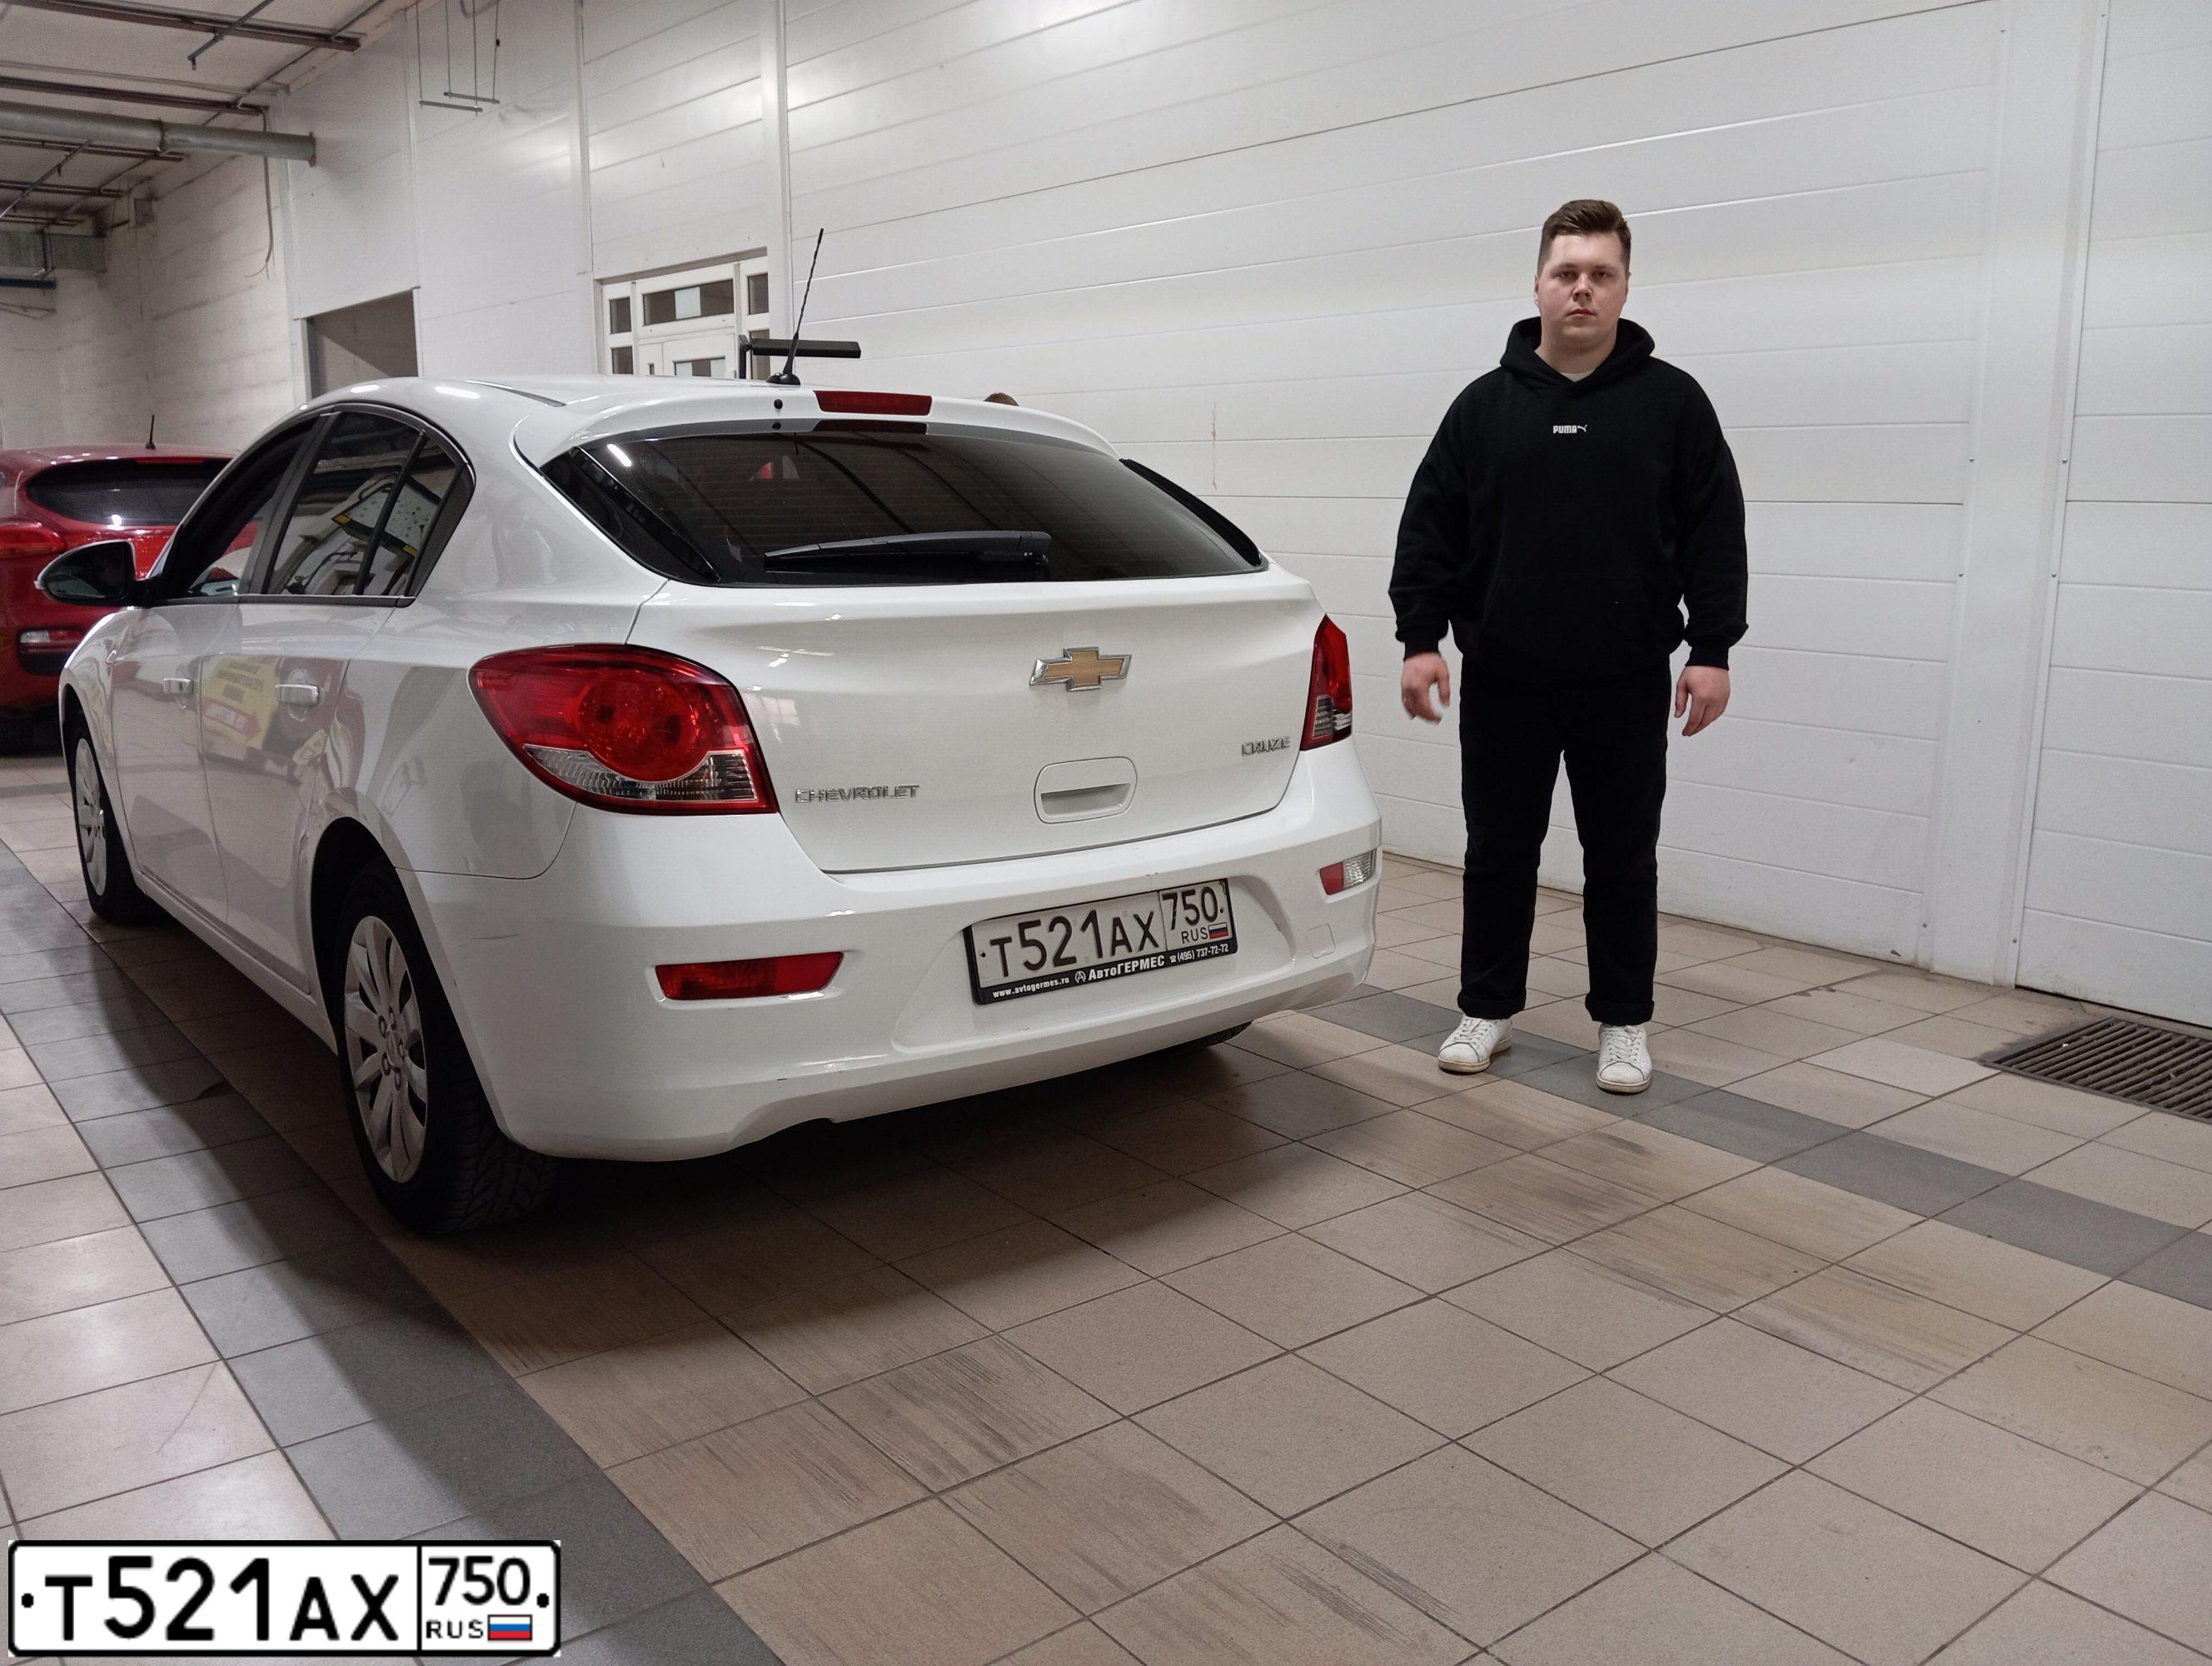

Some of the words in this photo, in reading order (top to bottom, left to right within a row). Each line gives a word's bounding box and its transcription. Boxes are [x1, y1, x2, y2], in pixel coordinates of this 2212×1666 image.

[1553, 425, 1577, 434] PUMA
[1241, 736, 1291, 756] CRUZE
[795, 785, 920, 803] CHEVROLET
[1162, 886, 1218, 930] 750
[1181, 926, 1208, 945] RUS
[1177, 949, 1195, 964] (495)
[1196, 942, 1229, 958] 737-72-72
[992, 976, 1070, 999] www.avtogermes.ru
